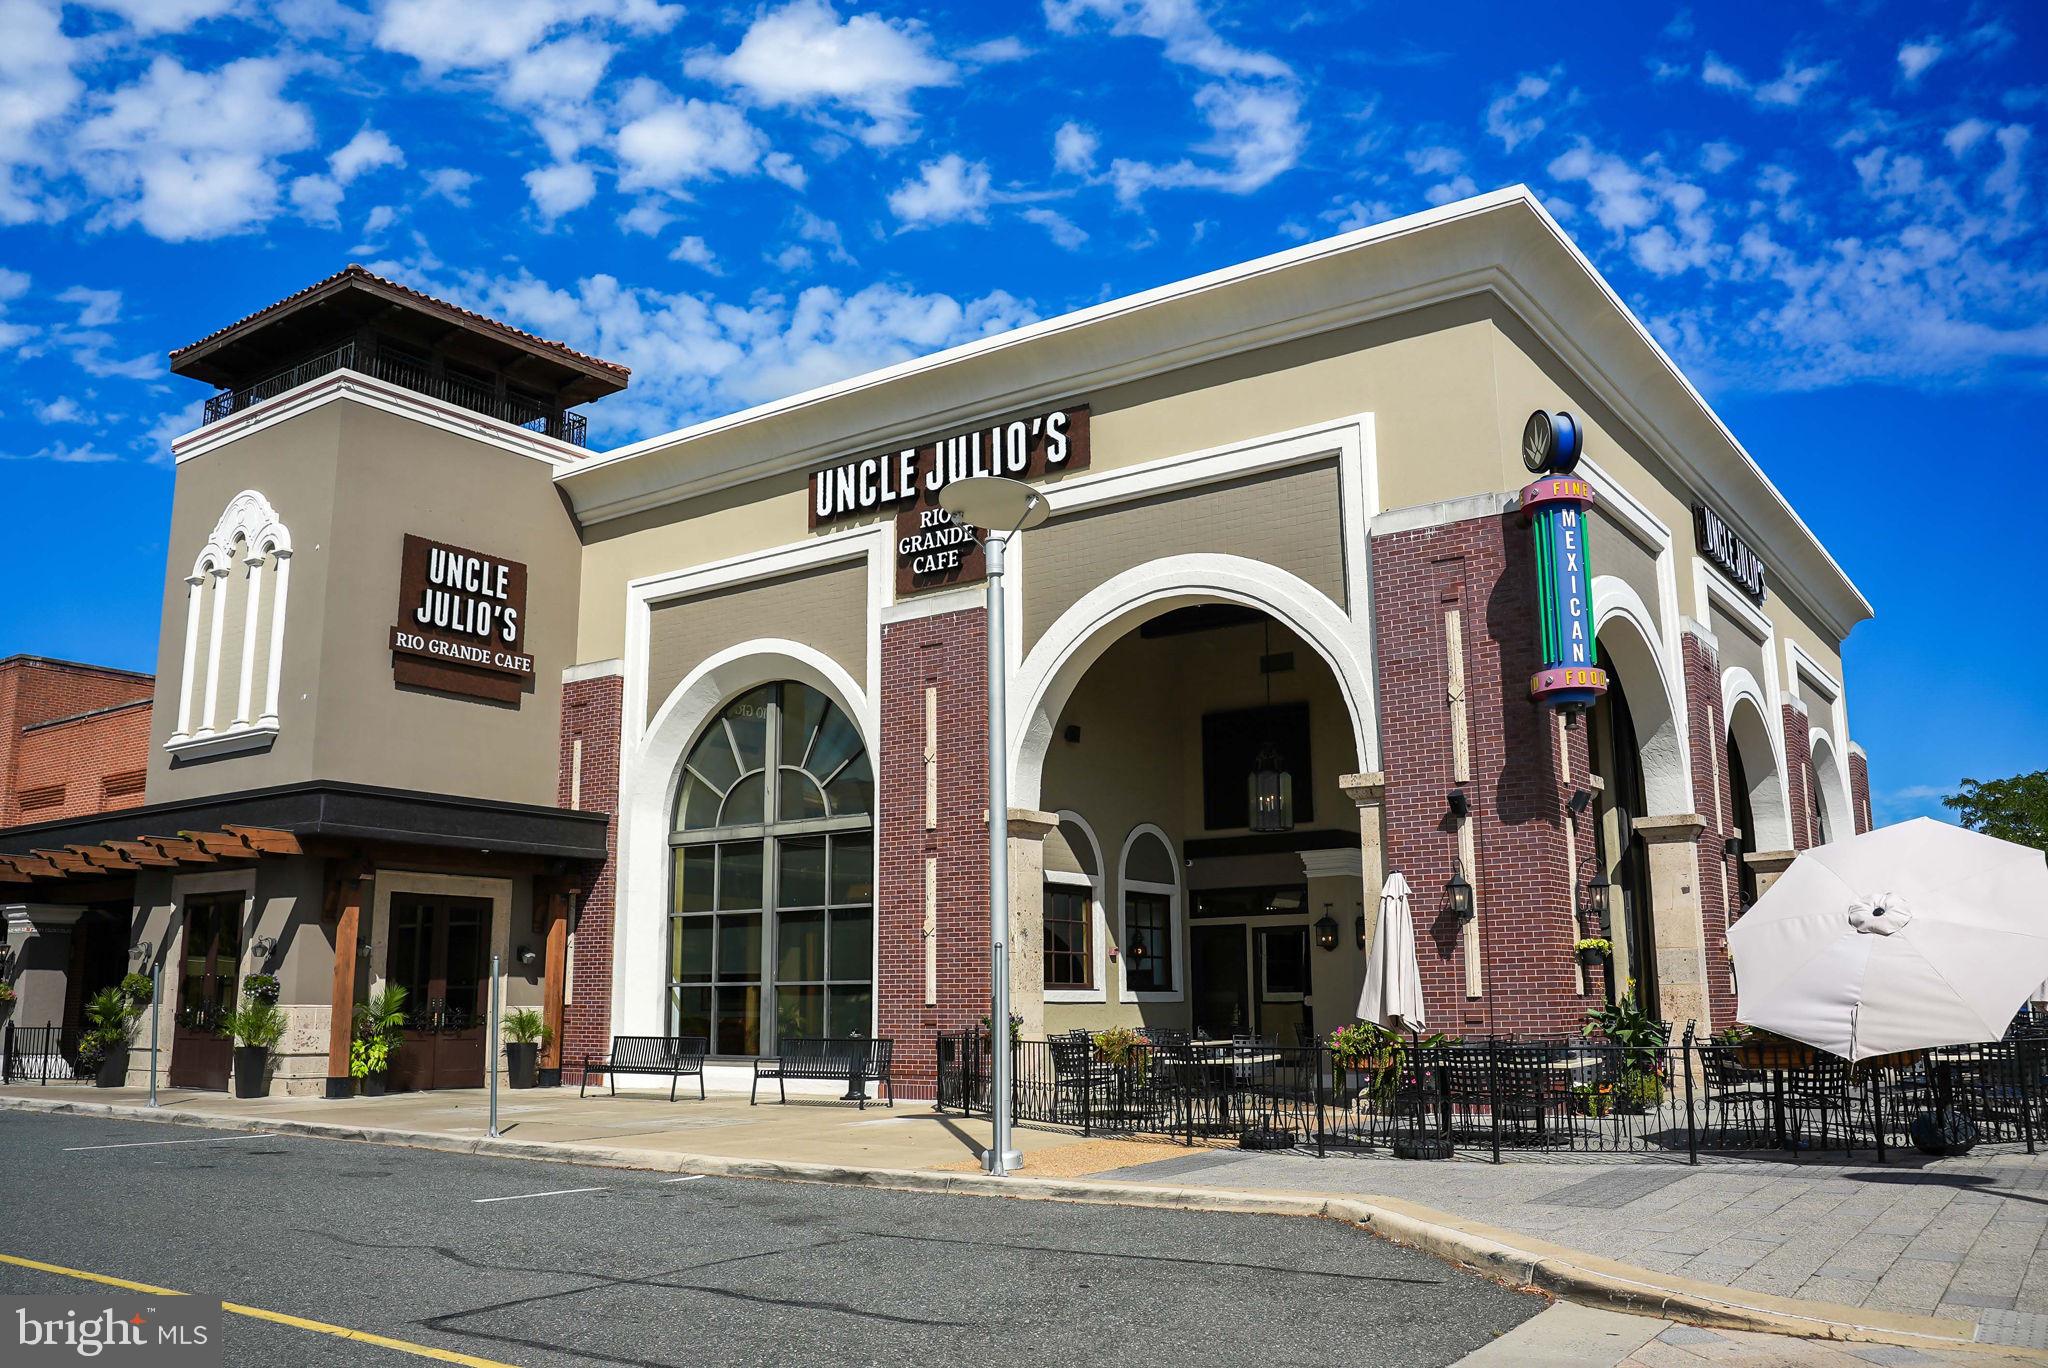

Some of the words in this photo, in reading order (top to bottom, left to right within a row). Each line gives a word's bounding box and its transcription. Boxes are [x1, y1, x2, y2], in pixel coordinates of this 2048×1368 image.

[816, 448, 915, 516] UNCLE
[926, 411, 1067, 491] JULIO'S
[1553, 481, 1588, 498] FINE
[920, 508, 951, 528] RIO
[899, 525, 974, 555] GRANDE
[1704, 506, 1736, 571] UNCLE
[1736, 538, 1767, 600] JULIO'S
[429, 547, 510, 600] UNCLE
[913, 550, 959, 574] CAFE
[1562, 508, 1584, 662] MEXICAN
[417, 588, 518, 642] JULIO'S
[396, 632, 424, 650] RIO
[428, 639, 491, 664] GRANDE
[494, 653, 531, 672] CAFE
[1565, 669, 1606, 686] FOOD
